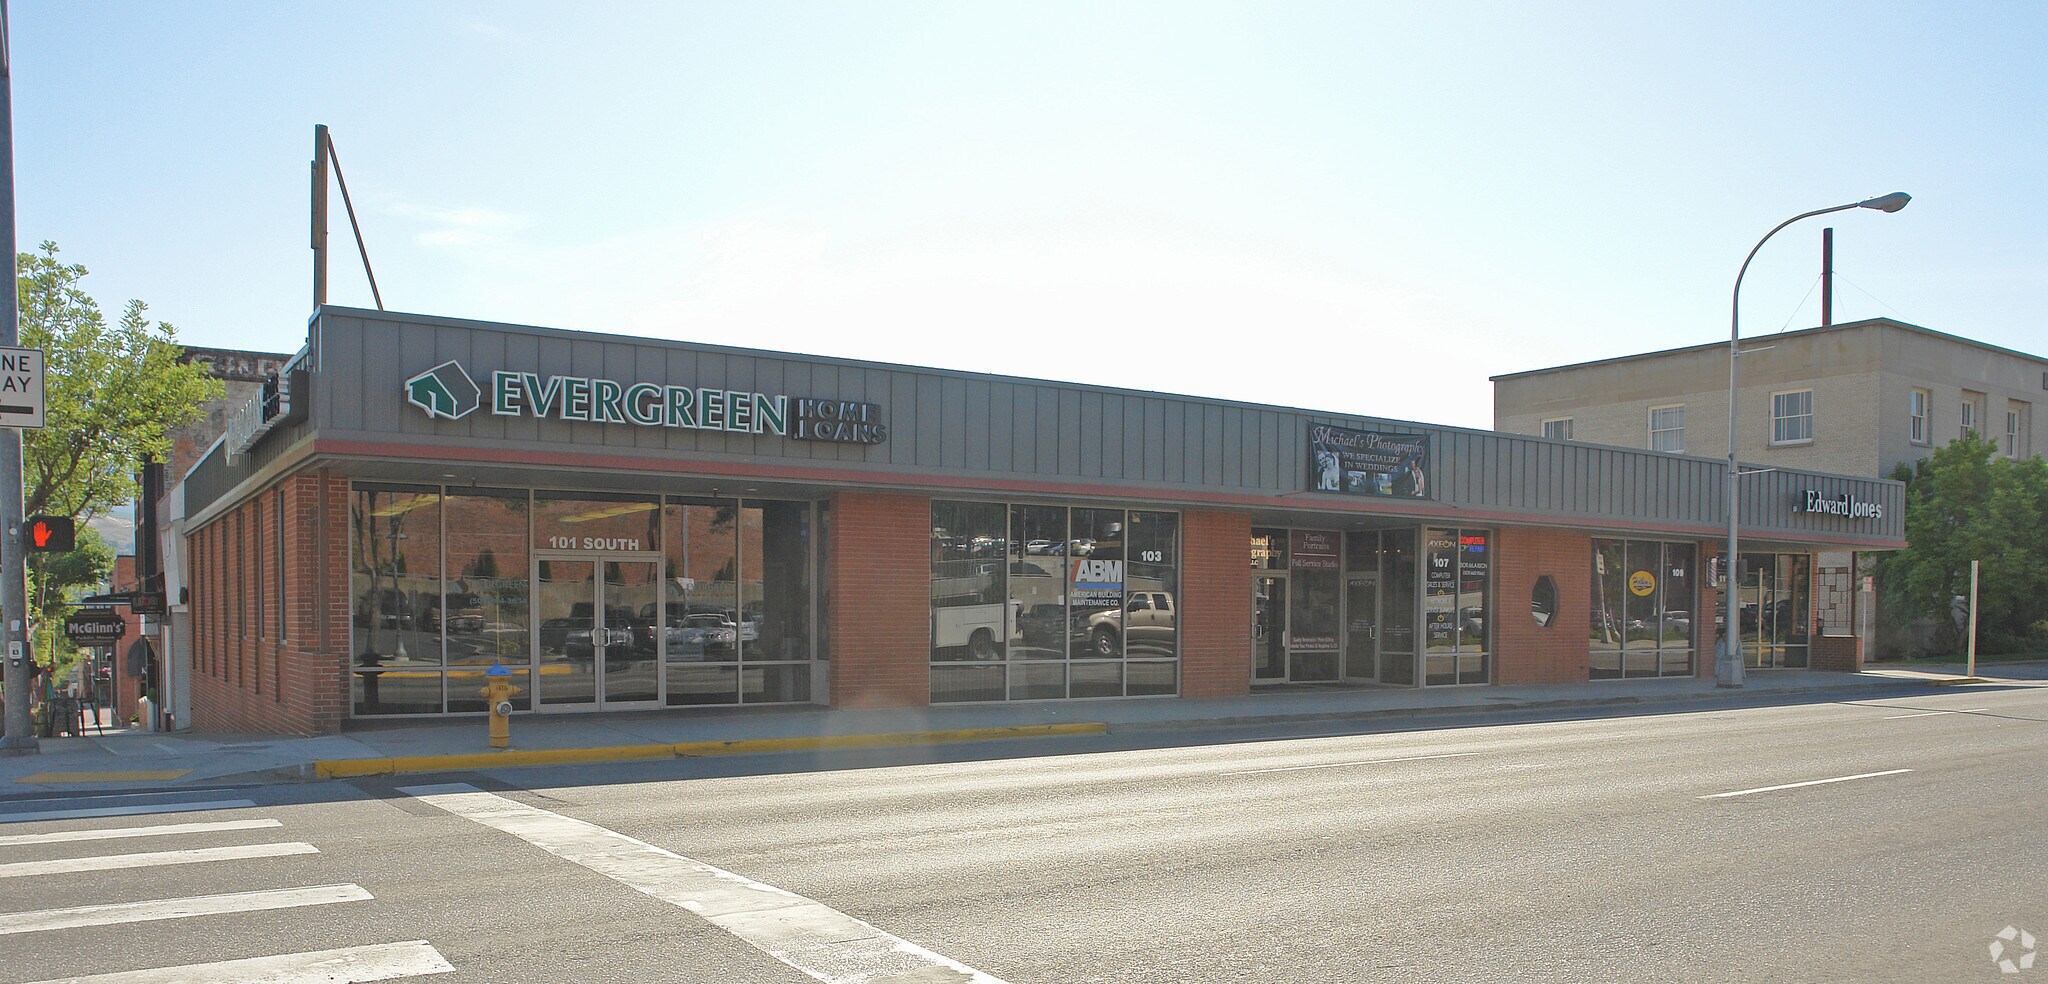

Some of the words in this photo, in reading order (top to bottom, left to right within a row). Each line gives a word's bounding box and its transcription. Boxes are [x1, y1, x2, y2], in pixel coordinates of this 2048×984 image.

[491, 369, 788, 436] EVERGREEN
[798, 398, 881, 422] HOME
[798, 420, 887, 445] LOANS
[1314, 426, 1364, 448] Michael's
[1366, 432, 1426, 458] Photography
[1342, 451, 1355, 460] WE
[1356, 453, 1401, 464] SPECIALIZE
[1355, 462, 1399, 473] WEDDINGS
[1805, 490, 1849, 516] Edward
[1849, 494, 1882, 519] Jones
[549, 536, 577, 549] 101
[583, 537, 639, 551] SOUTH
[1305, 534, 1326, 543] Family
[1141, 550, 1162, 562] 103
[1433, 558, 1449, 568] 107
[1075, 559, 1123, 583] ABM
[1672, 568, 1685, 577] 109
[1098, 591, 1122, 599] BUILDING
[68, 621, 121, 634] McGlinn's
